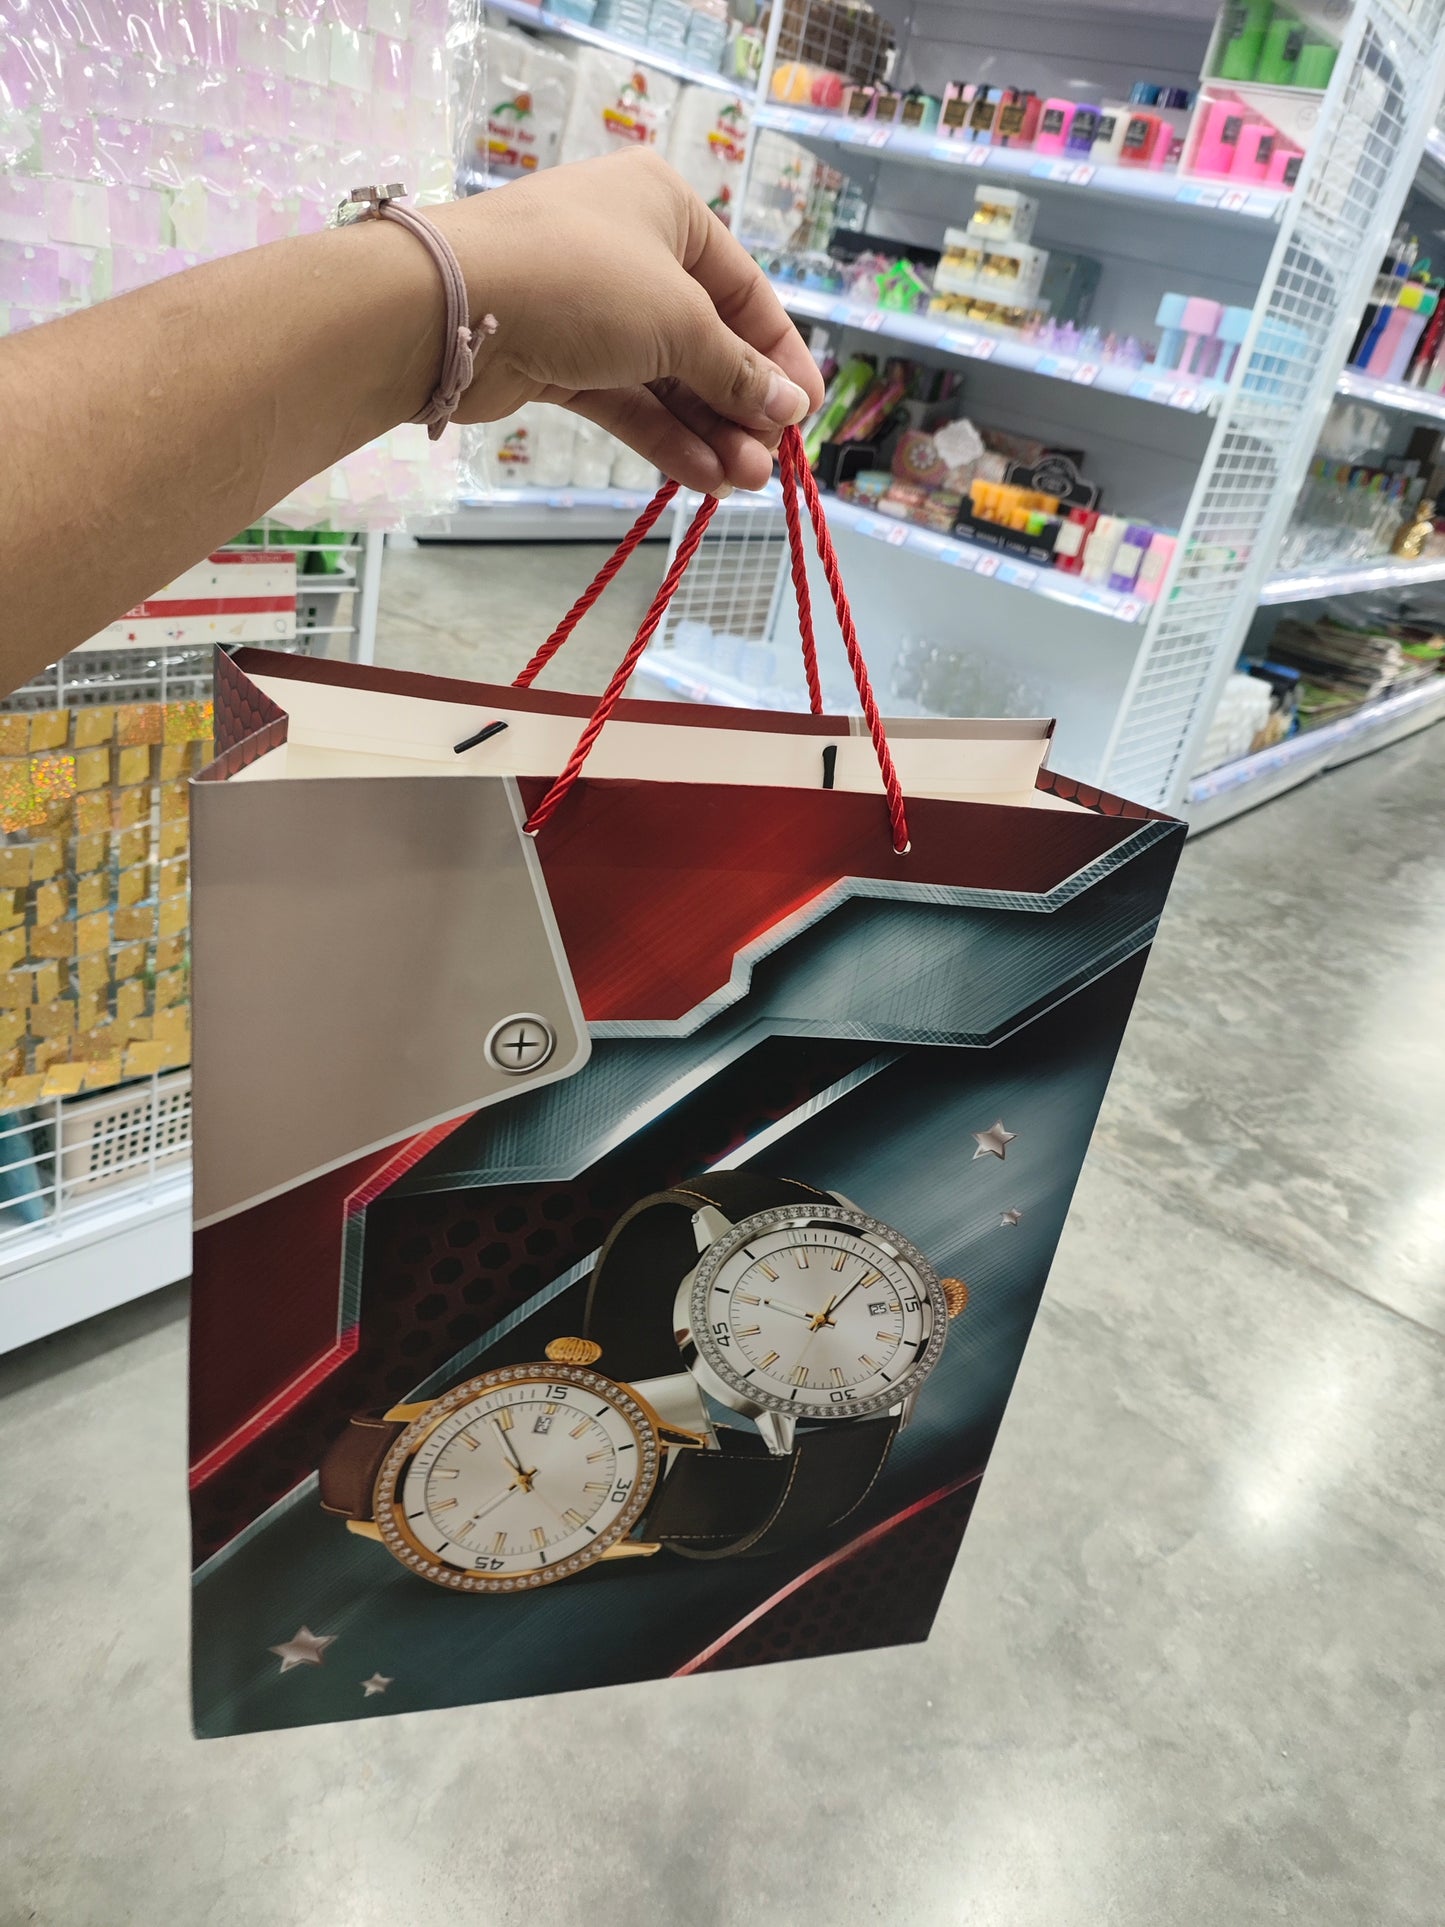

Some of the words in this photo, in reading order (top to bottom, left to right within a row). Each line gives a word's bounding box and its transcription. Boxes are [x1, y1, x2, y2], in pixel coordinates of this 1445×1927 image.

[871, 1304, 887, 1315] 25
[903, 1294, 920, 1313] 15
[712, 1321, 731, 1347] 45
[545, 1384, 569, 1400] 15
[829, 1388, 858, 1403] 30
[611, 1477, 633, 1503] 30
[474, 1556, 505, 1571] 45
